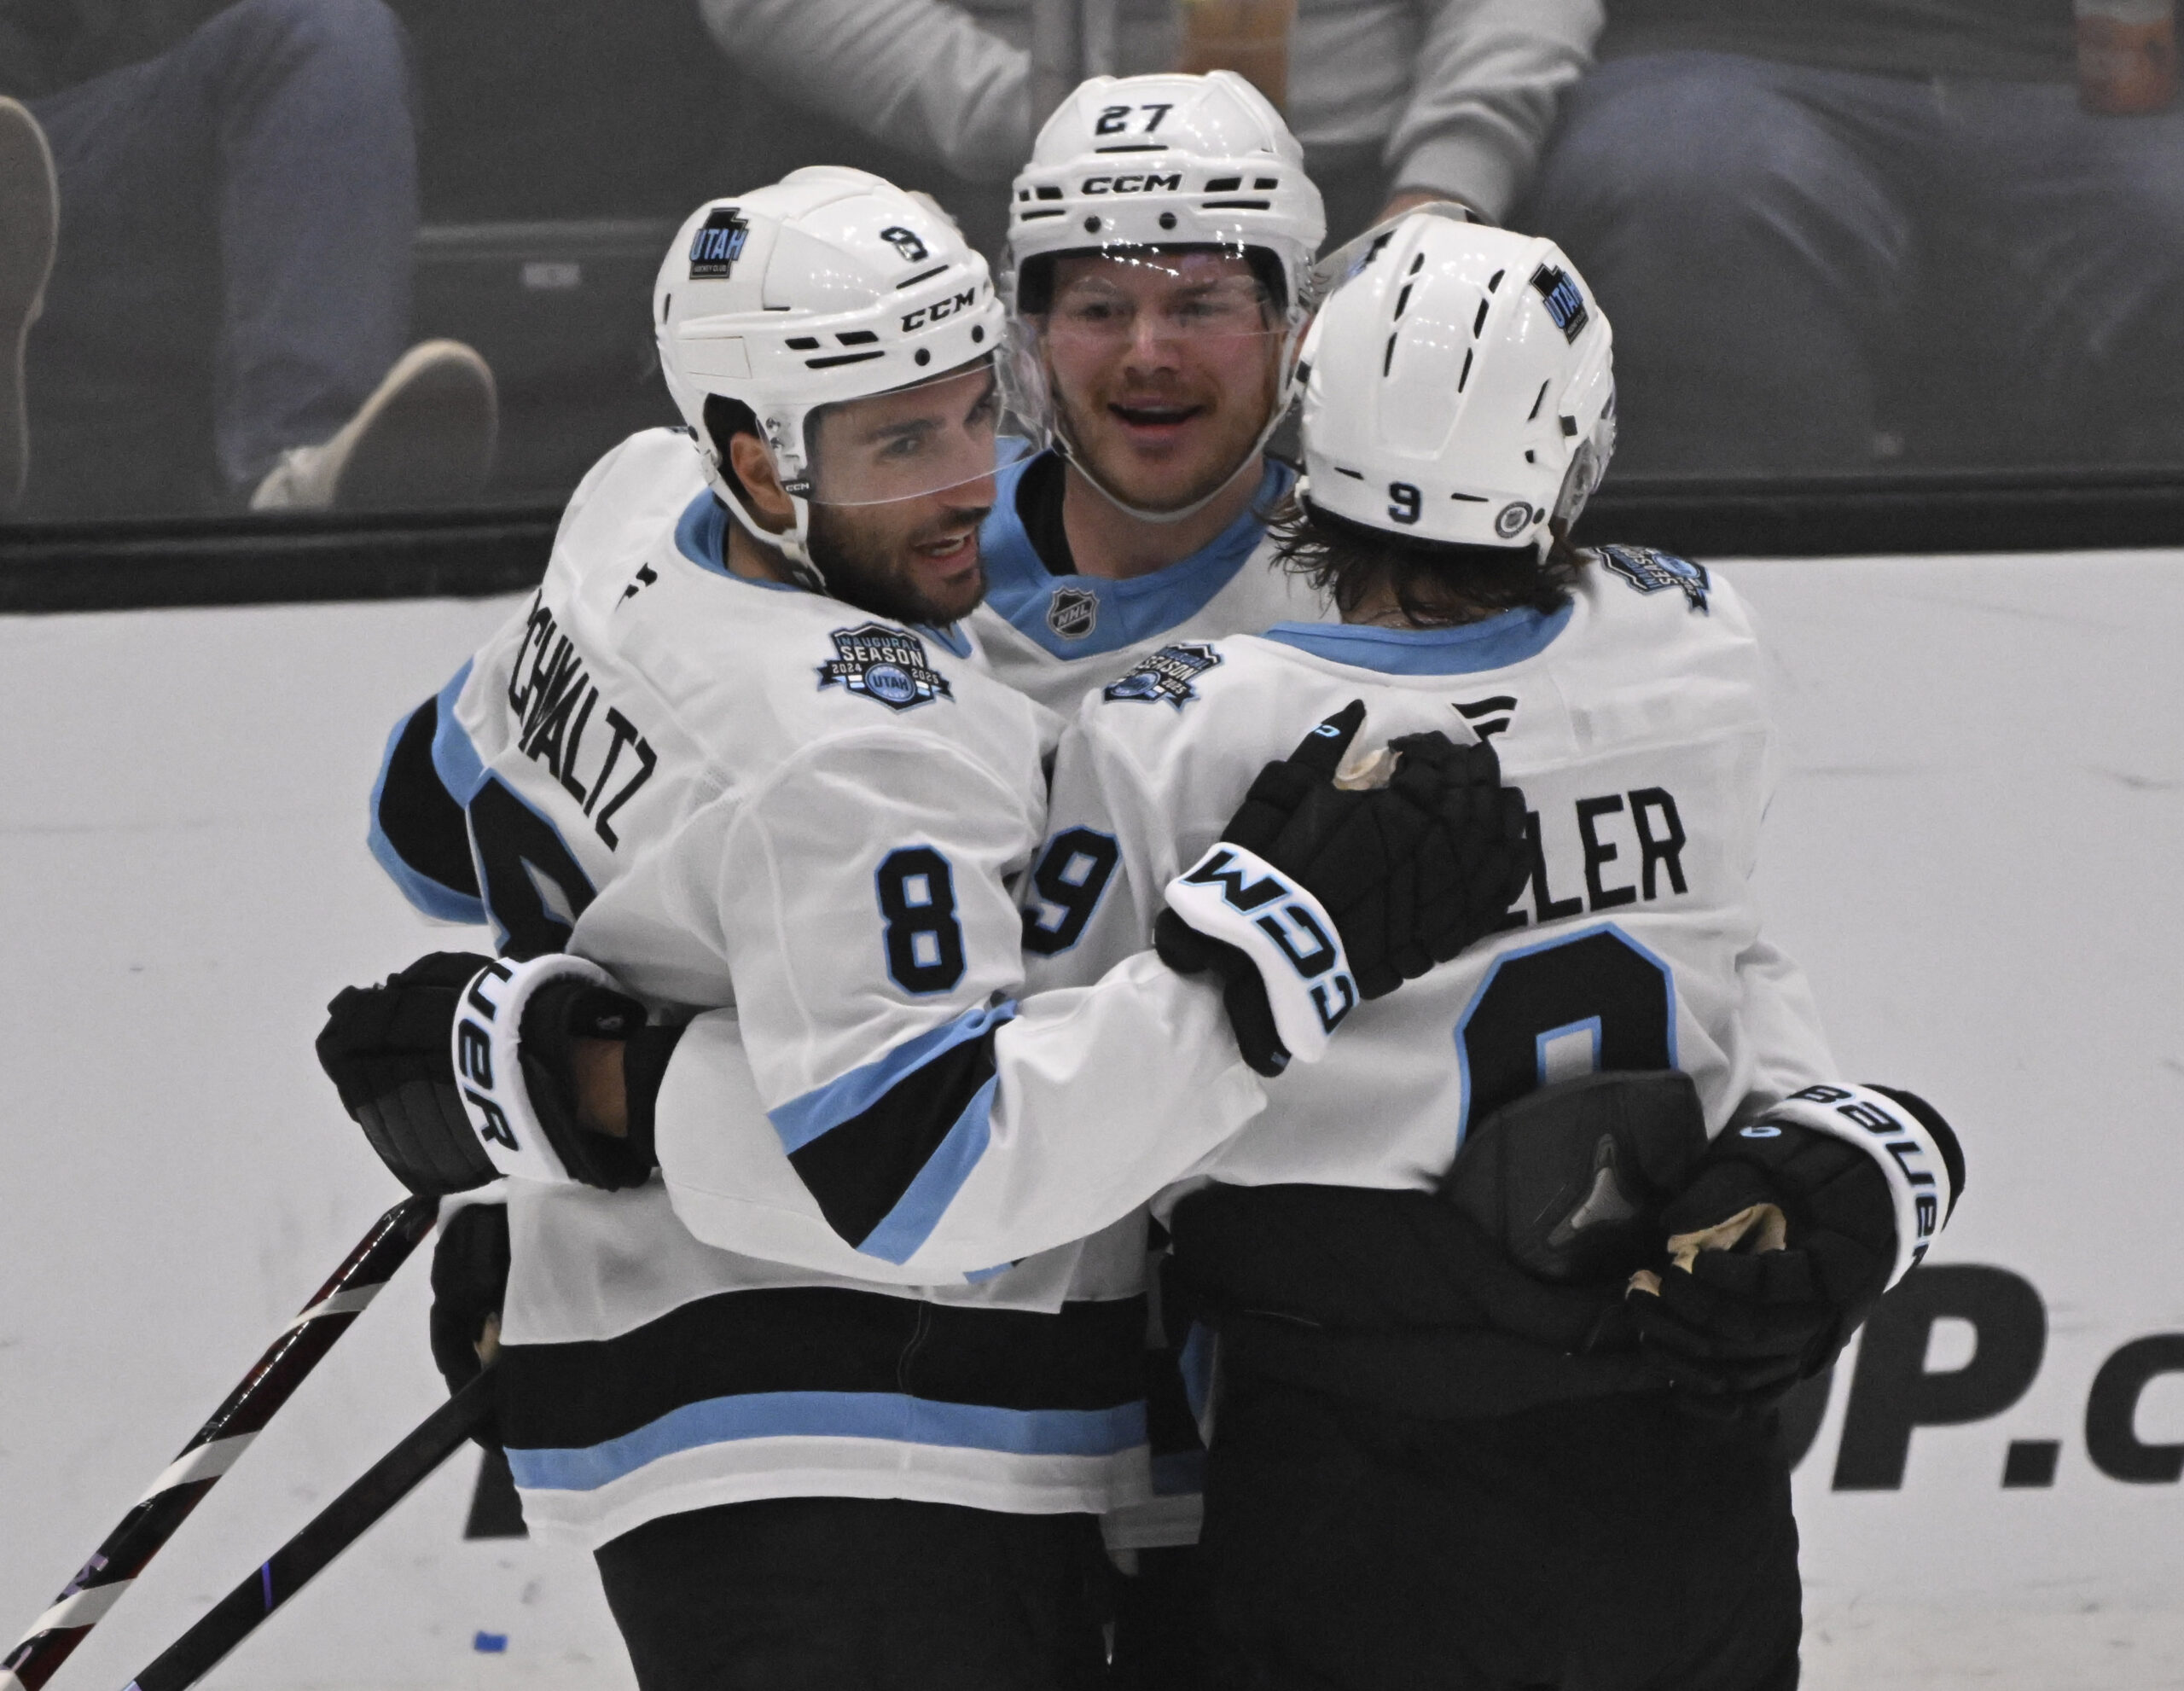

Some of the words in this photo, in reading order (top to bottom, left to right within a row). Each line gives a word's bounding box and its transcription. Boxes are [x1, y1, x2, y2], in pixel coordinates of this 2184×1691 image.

[1095, 103, 1173, 136] 27
[1081, 173, 1182, 195] CCM
[689, 228, 749, 260] UTAH
[900, 287, 975, 333] CCM
[1542, 271, 1584, 328] UTAH
[785, 482, 810, 492] CCM
[1387, 480, 1423, 526] 9
[1058, 603, 1090, 626] NHL
[836, 636, 921, 652] INAUGURAL
[839, 645, 925, 668] SEASON
[832, 663, 863, 674] 2024
[911, 667, 939, 684] 2025
[872, 675, 909, 692] UTAH
[1137, 655, 1199, 682] SEASON
[1502, 786, 1689, 930] LER
[1021, 824, 1124, 959] 9
[874, 844, 967, 997] 8
[1179, 848, 1359, 1037] CCM
